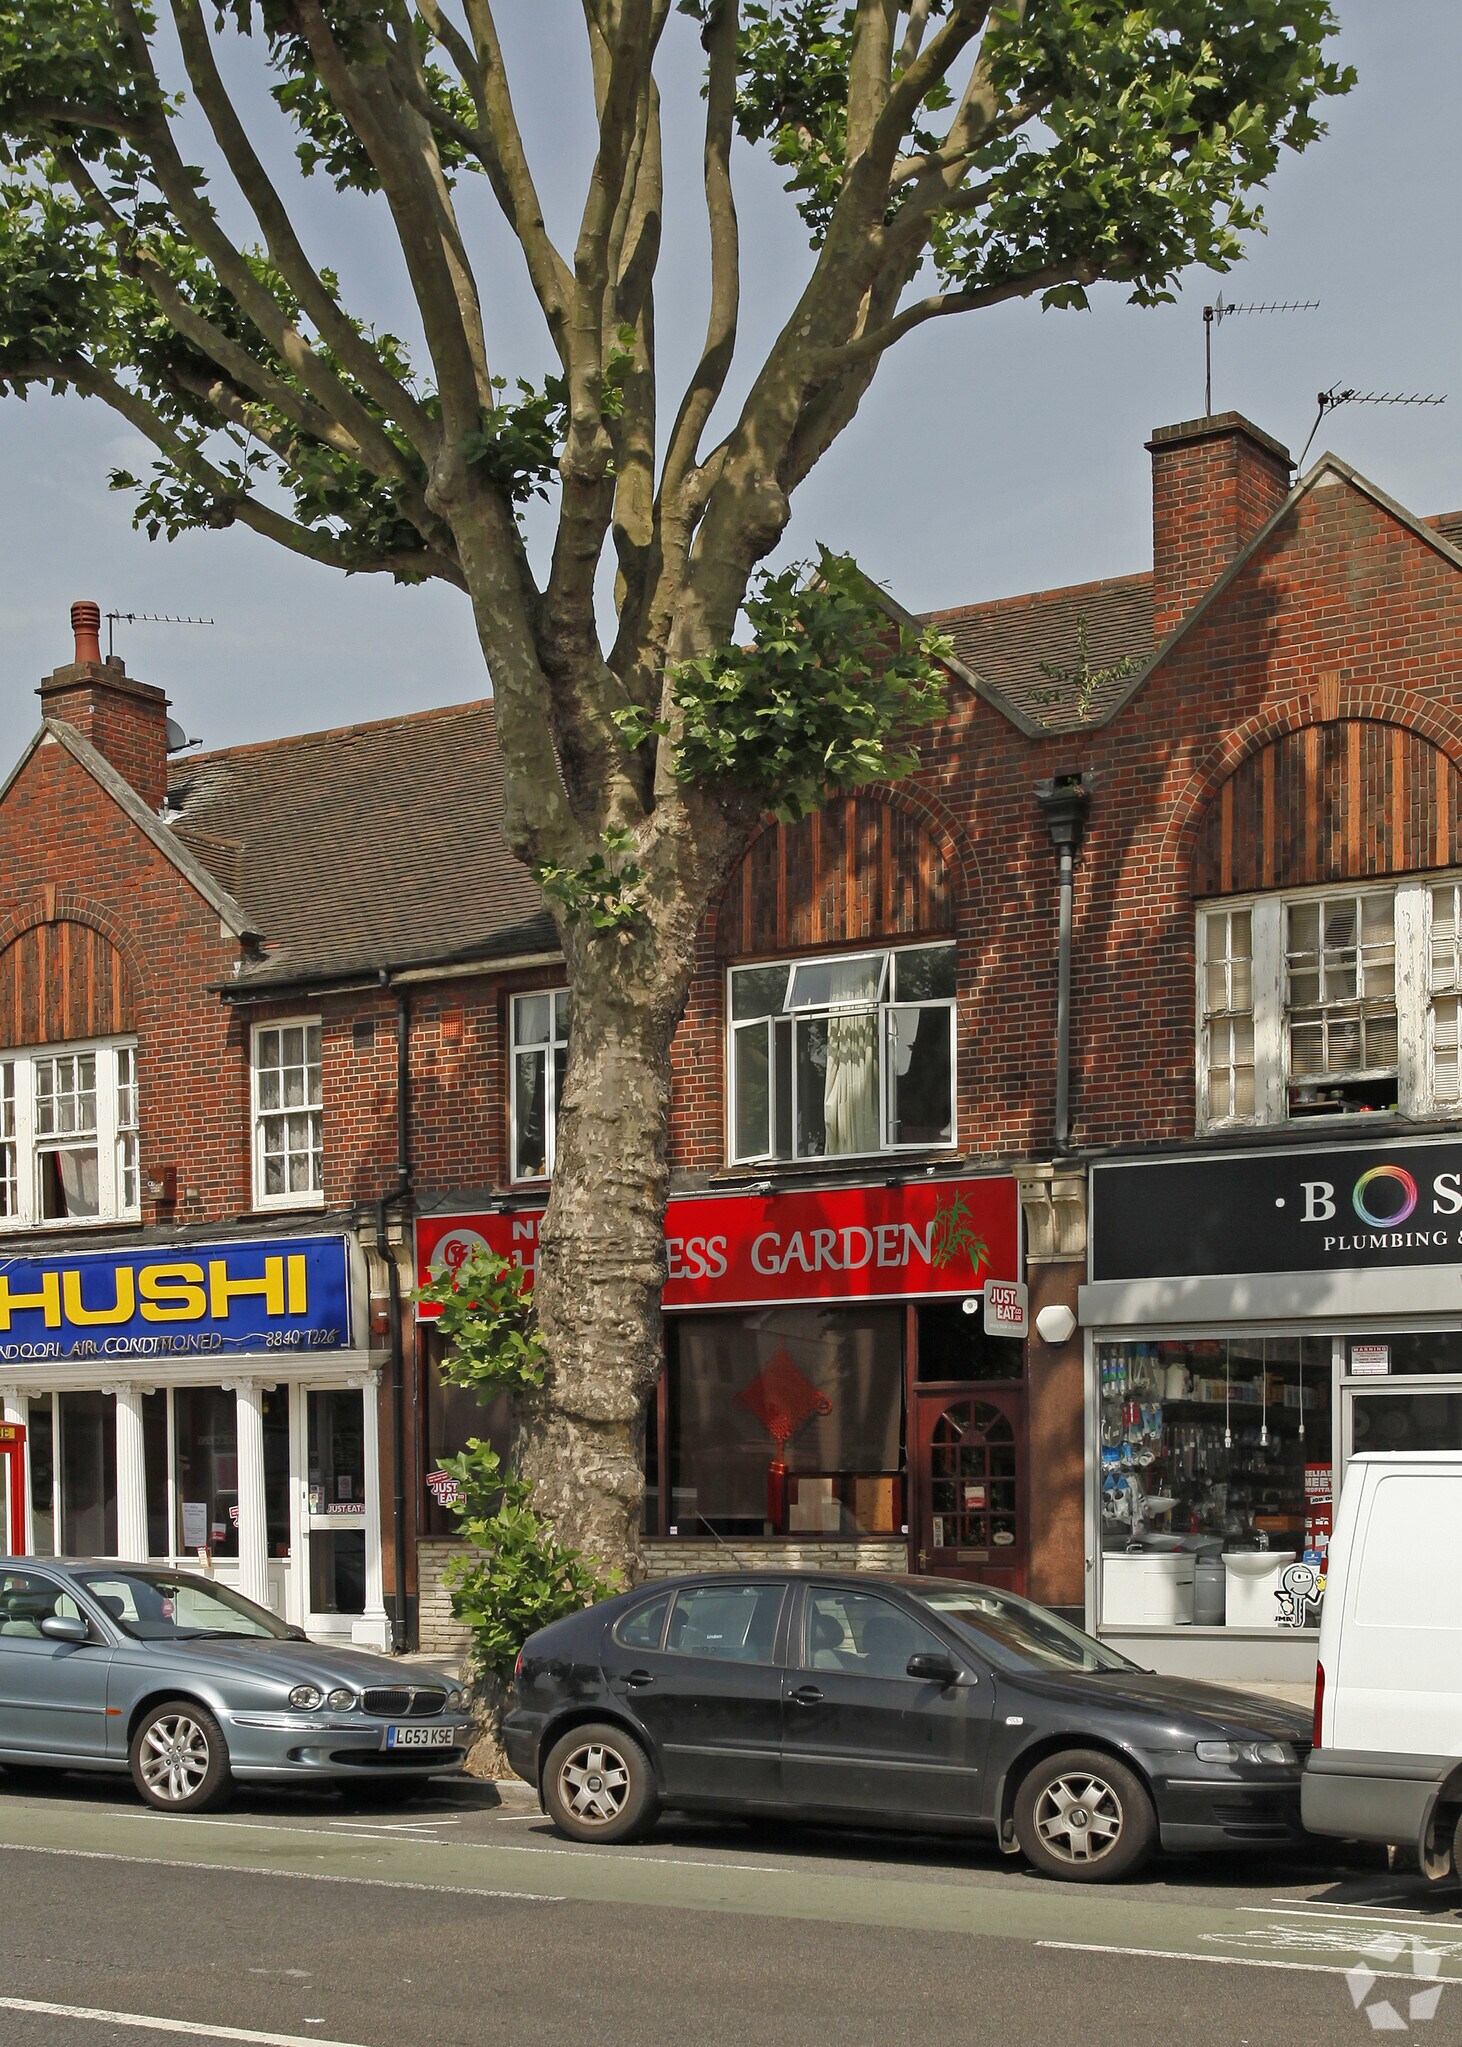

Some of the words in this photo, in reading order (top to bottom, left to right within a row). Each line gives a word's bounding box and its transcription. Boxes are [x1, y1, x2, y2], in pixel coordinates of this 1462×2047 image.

[751, 1221, 935, 1275] GARDEN
[1324, 1231, 1448, 1250] PLUMBING
[991, 1289, 1016, 1304] JUST
[997, 1305, 1015, 1319] EAT
[104, 1333, 222, 1353] CONDITIONED
[434, 1483, 458, 1493] JUST
[440, 1494, 458, 1503] EAT
[328, 1504, 346, 1513] JUST
[347, 1504, 361, 1512] EAT
[396, 1729, 429, 1744] LG53
[431, 1729, 452, 1744] KSE
